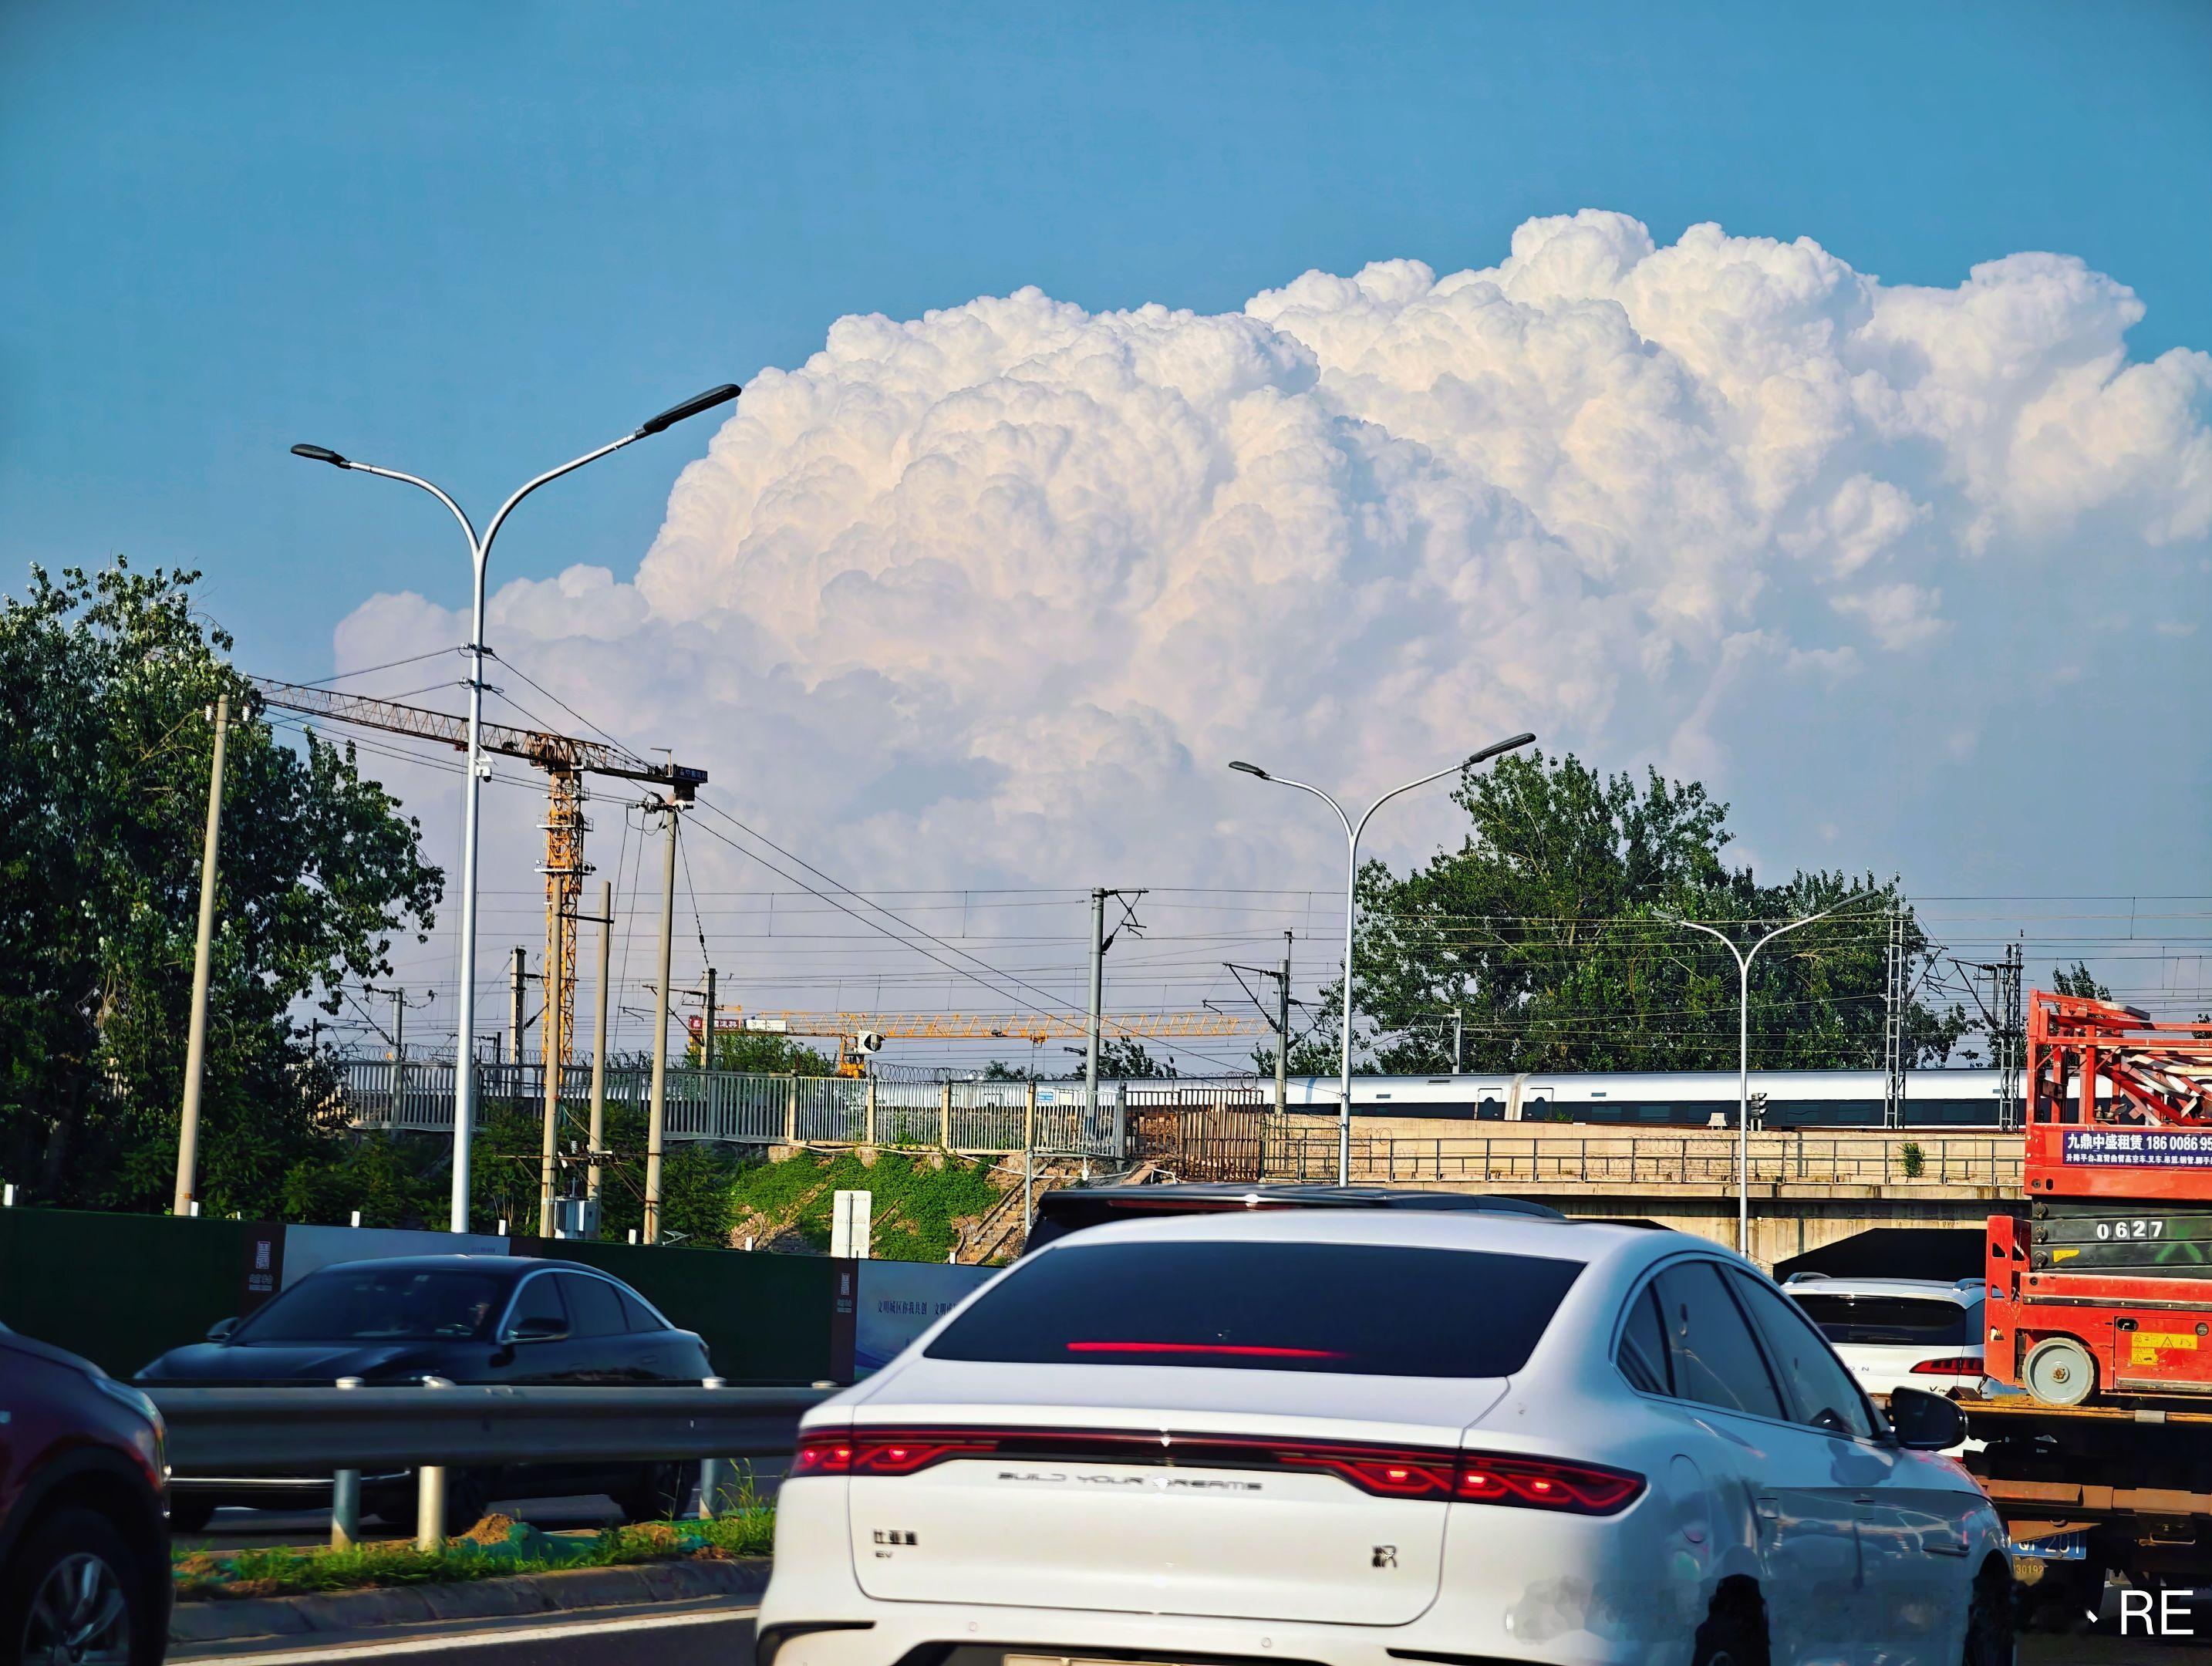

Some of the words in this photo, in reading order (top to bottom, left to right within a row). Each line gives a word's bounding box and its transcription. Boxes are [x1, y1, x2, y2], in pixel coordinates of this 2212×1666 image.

[2068, 1133, 2143, 1150] 九鼎中盛租赁
[2146, 1135, 2167, 1150] 186
[2170, 1136, 2198, 1151] 0086
[2096, 1220, 2163, 1239] 0627
[998, 1472, 1067, 1482] BUILD
[1077, 1475, 1143, 1485] YOUR
[1154, 1477, 1263, 1490] REAMS
